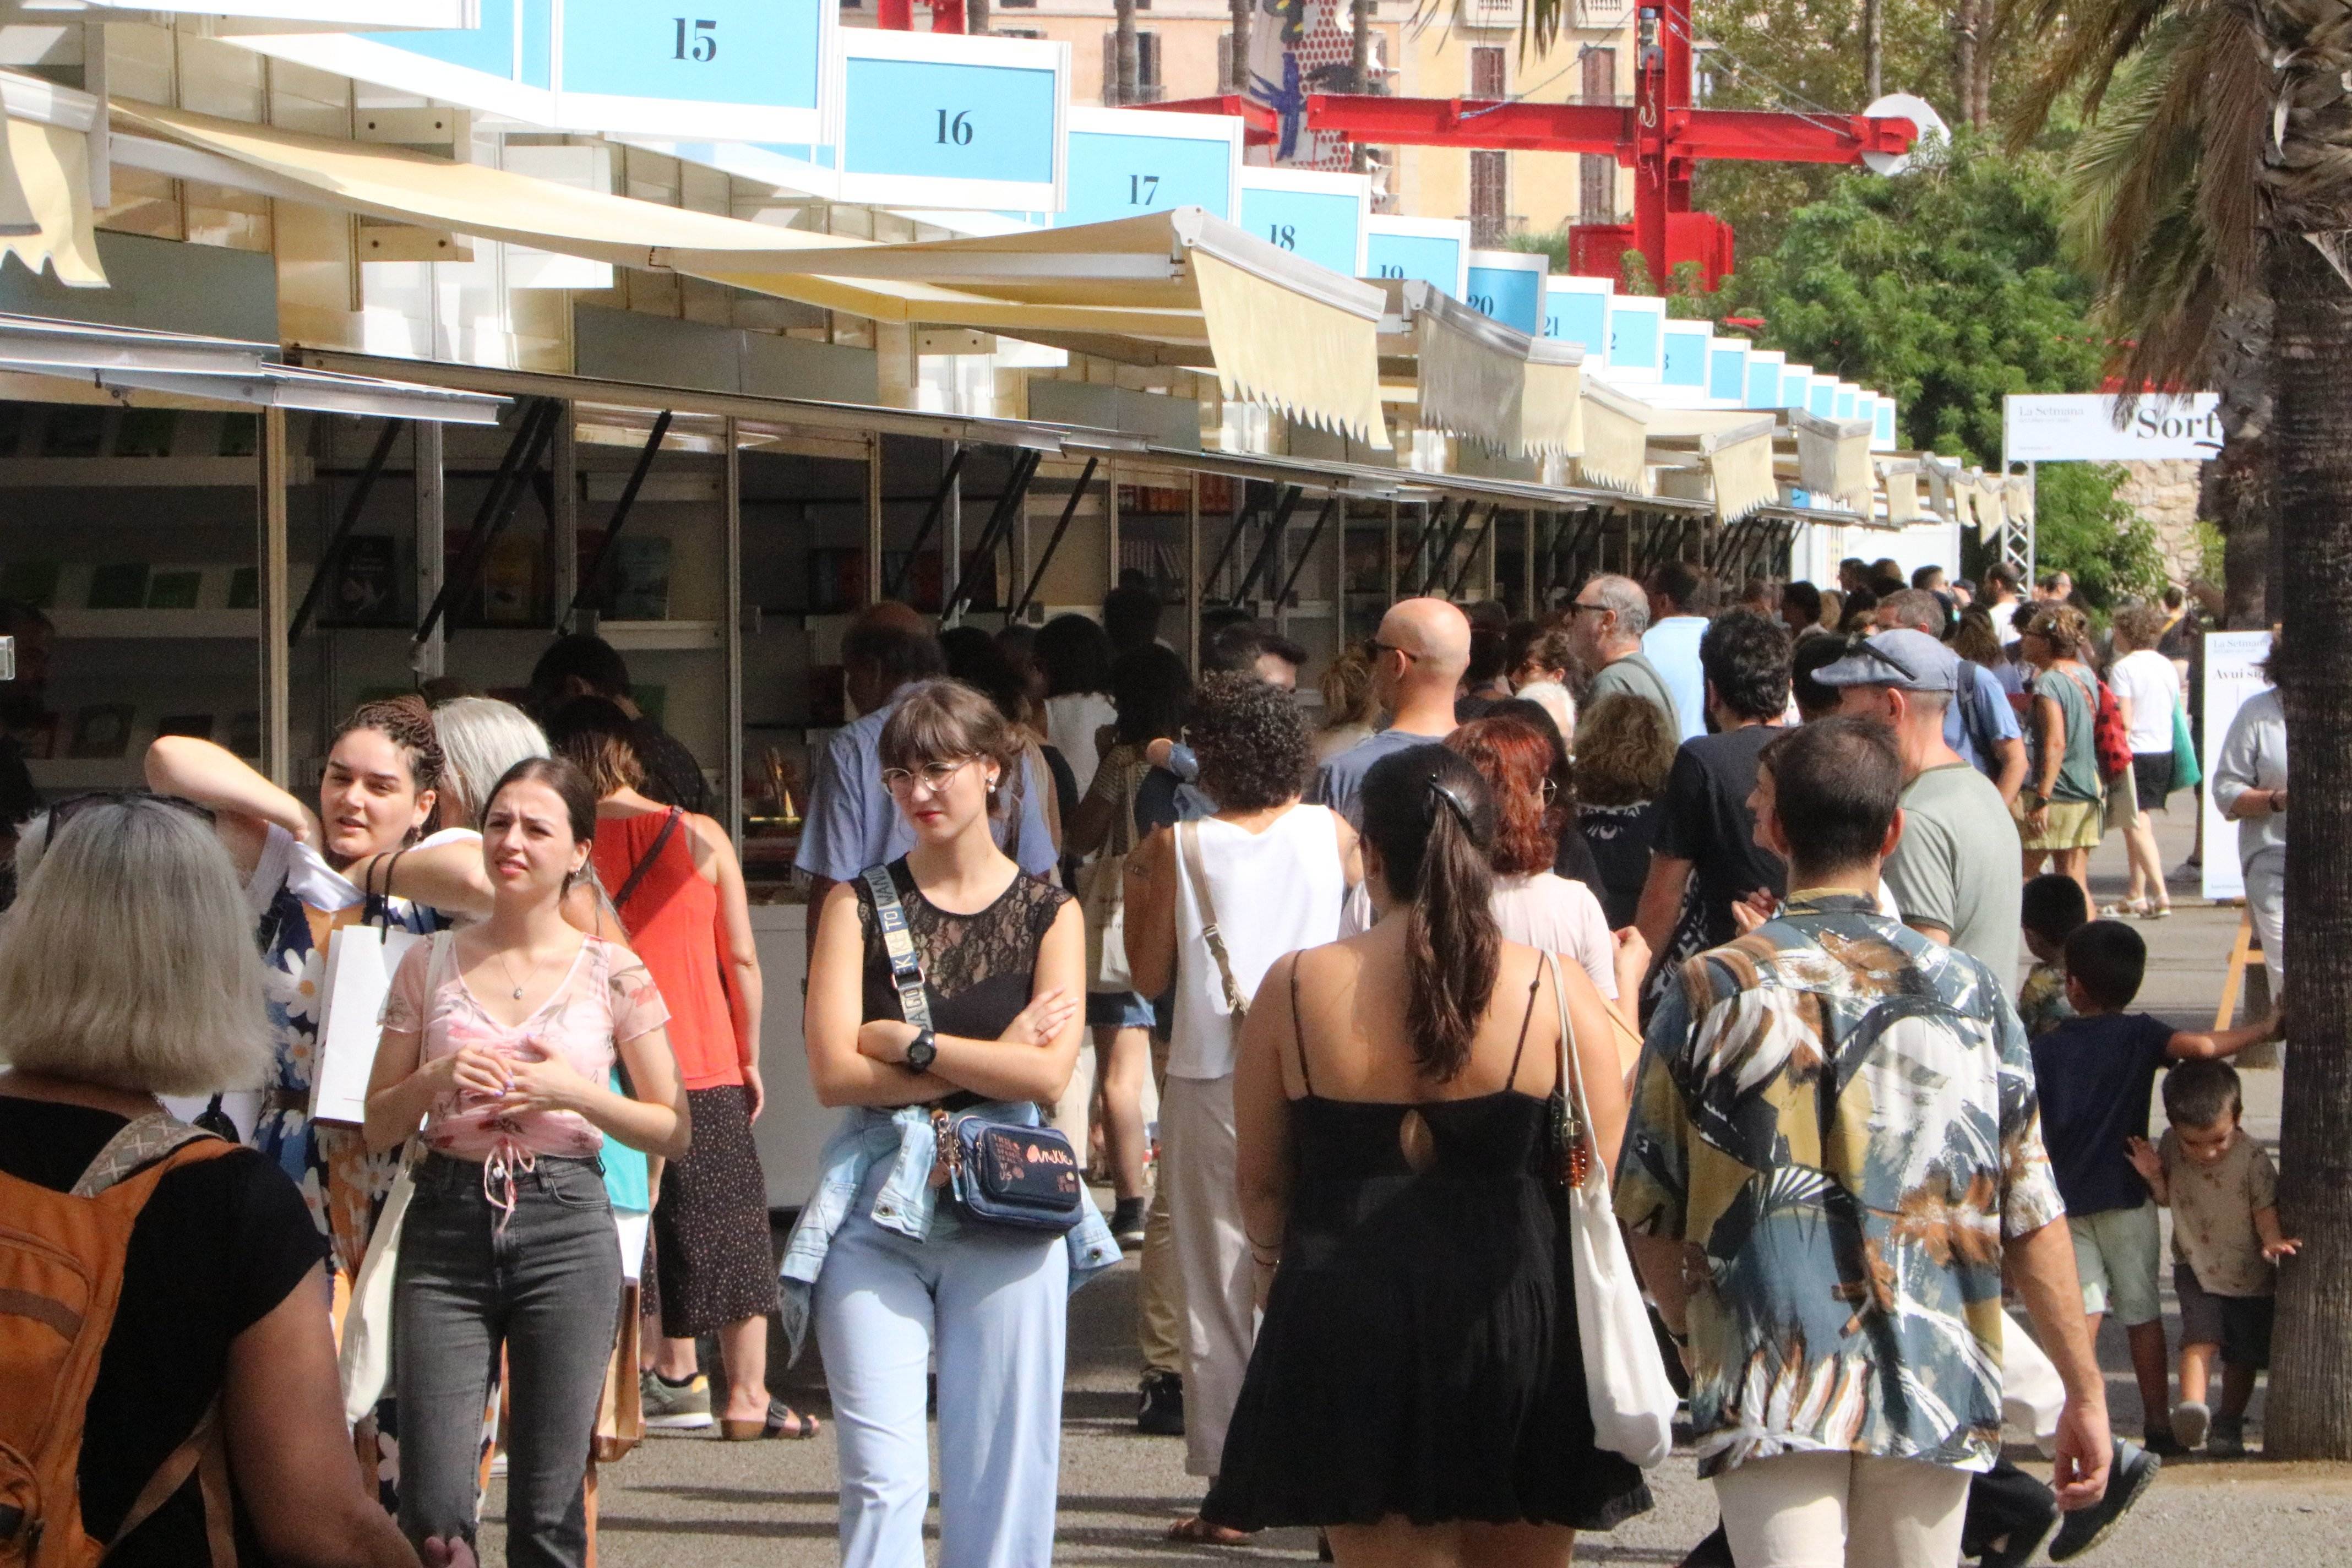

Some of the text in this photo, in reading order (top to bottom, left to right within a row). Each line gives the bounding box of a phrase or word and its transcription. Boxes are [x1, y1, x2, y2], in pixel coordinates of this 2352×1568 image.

[671, 18, 716, 62] 15
[935, 109, 973, 145] 16
[1128, 175, 1159, 205] 17
[1271, 225, 1295, 252] 18
[1543, 317, 1558, 336] 21
[2019, 406, 2084, 417] La Setmana
[2136, 408, 2219, 439] Sort
[2214, 668, 2244, 679] Avui
